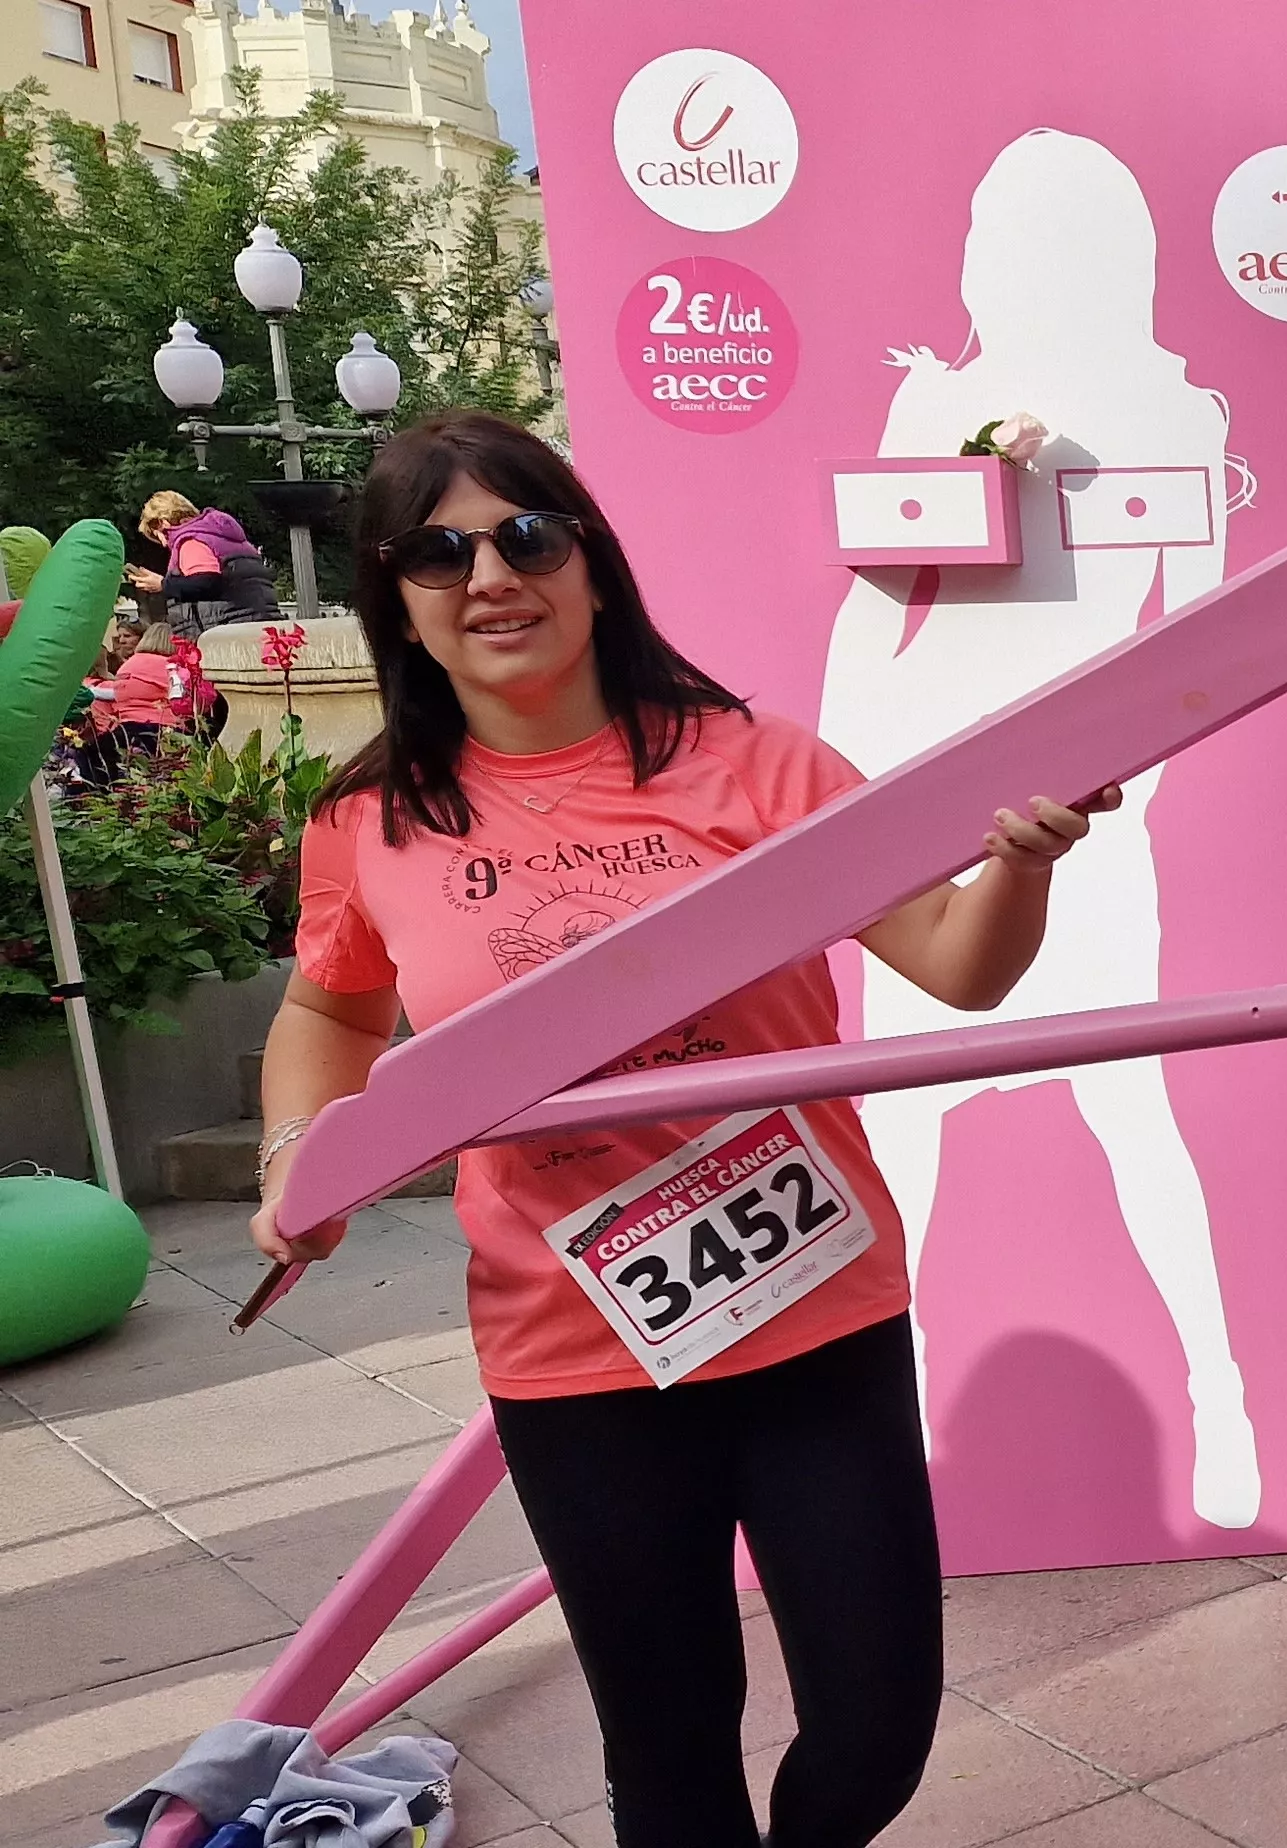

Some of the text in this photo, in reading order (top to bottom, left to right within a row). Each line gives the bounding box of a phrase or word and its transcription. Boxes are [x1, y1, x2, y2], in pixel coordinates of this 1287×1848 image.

[637, 149, 781, 186] castellar
[647, 274, 770, 336] 2€/ud.
[642, 341, 772, 365] a beneficio
[652, 374, 768, 401] aecc
[671, 401, 752, 412] Contra el Cáncer
[524, 834, 668, 872] CÁNCER
[601, 854, 701, 878] HUESCA
[653, 1038, 726, 1064] MUCHO
[597, 1134, 793, 1260] CONTRA EL CÁNCER
[657, 1158, 722, 1200] HUESCA
[582, 1209, 618, 1246] EDICIÓN
[616, 1162, 839, 1331] 3452
[781, 1261, 818, 1290] castellar
